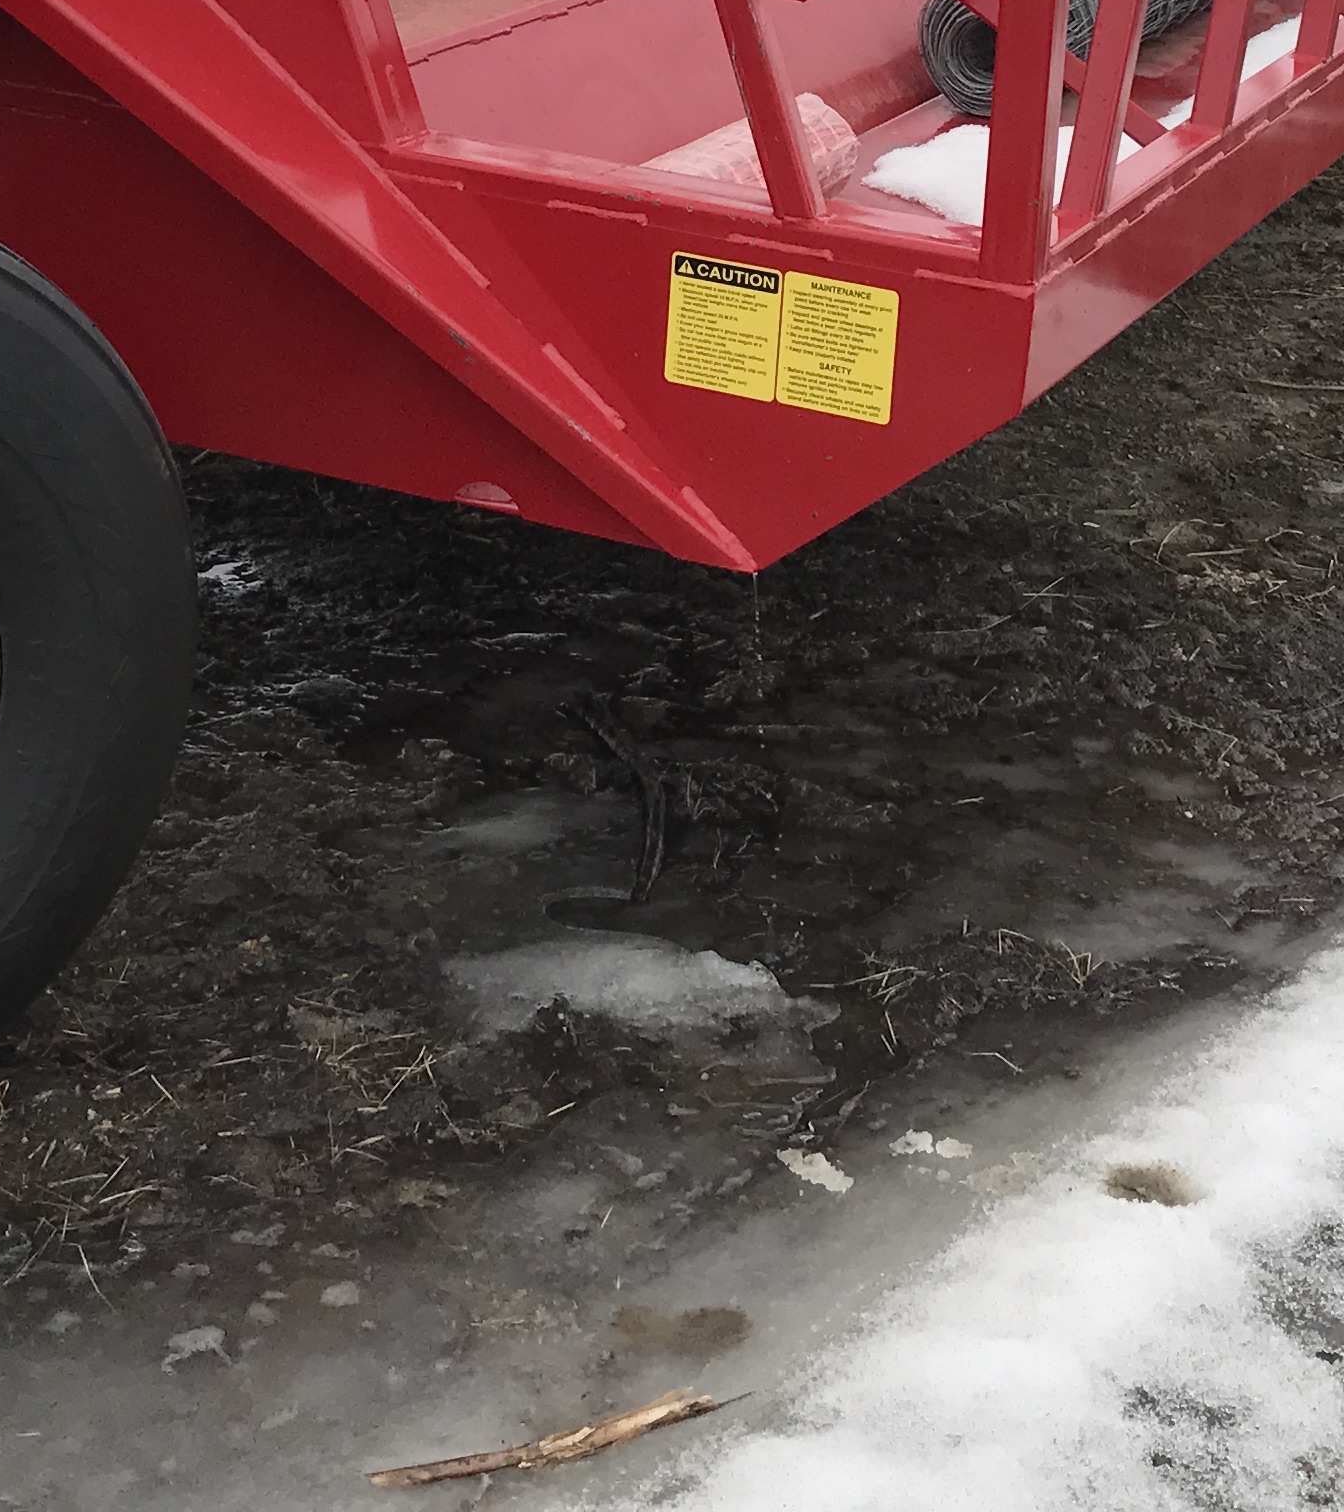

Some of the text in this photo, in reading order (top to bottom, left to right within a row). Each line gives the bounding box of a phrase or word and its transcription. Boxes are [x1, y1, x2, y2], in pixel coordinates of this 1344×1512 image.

[697, 263, 775, 290] CAUTION
[811, 282, 871, 299] MAINTENANCE
[819, 362, 851, 375] SAFETY
